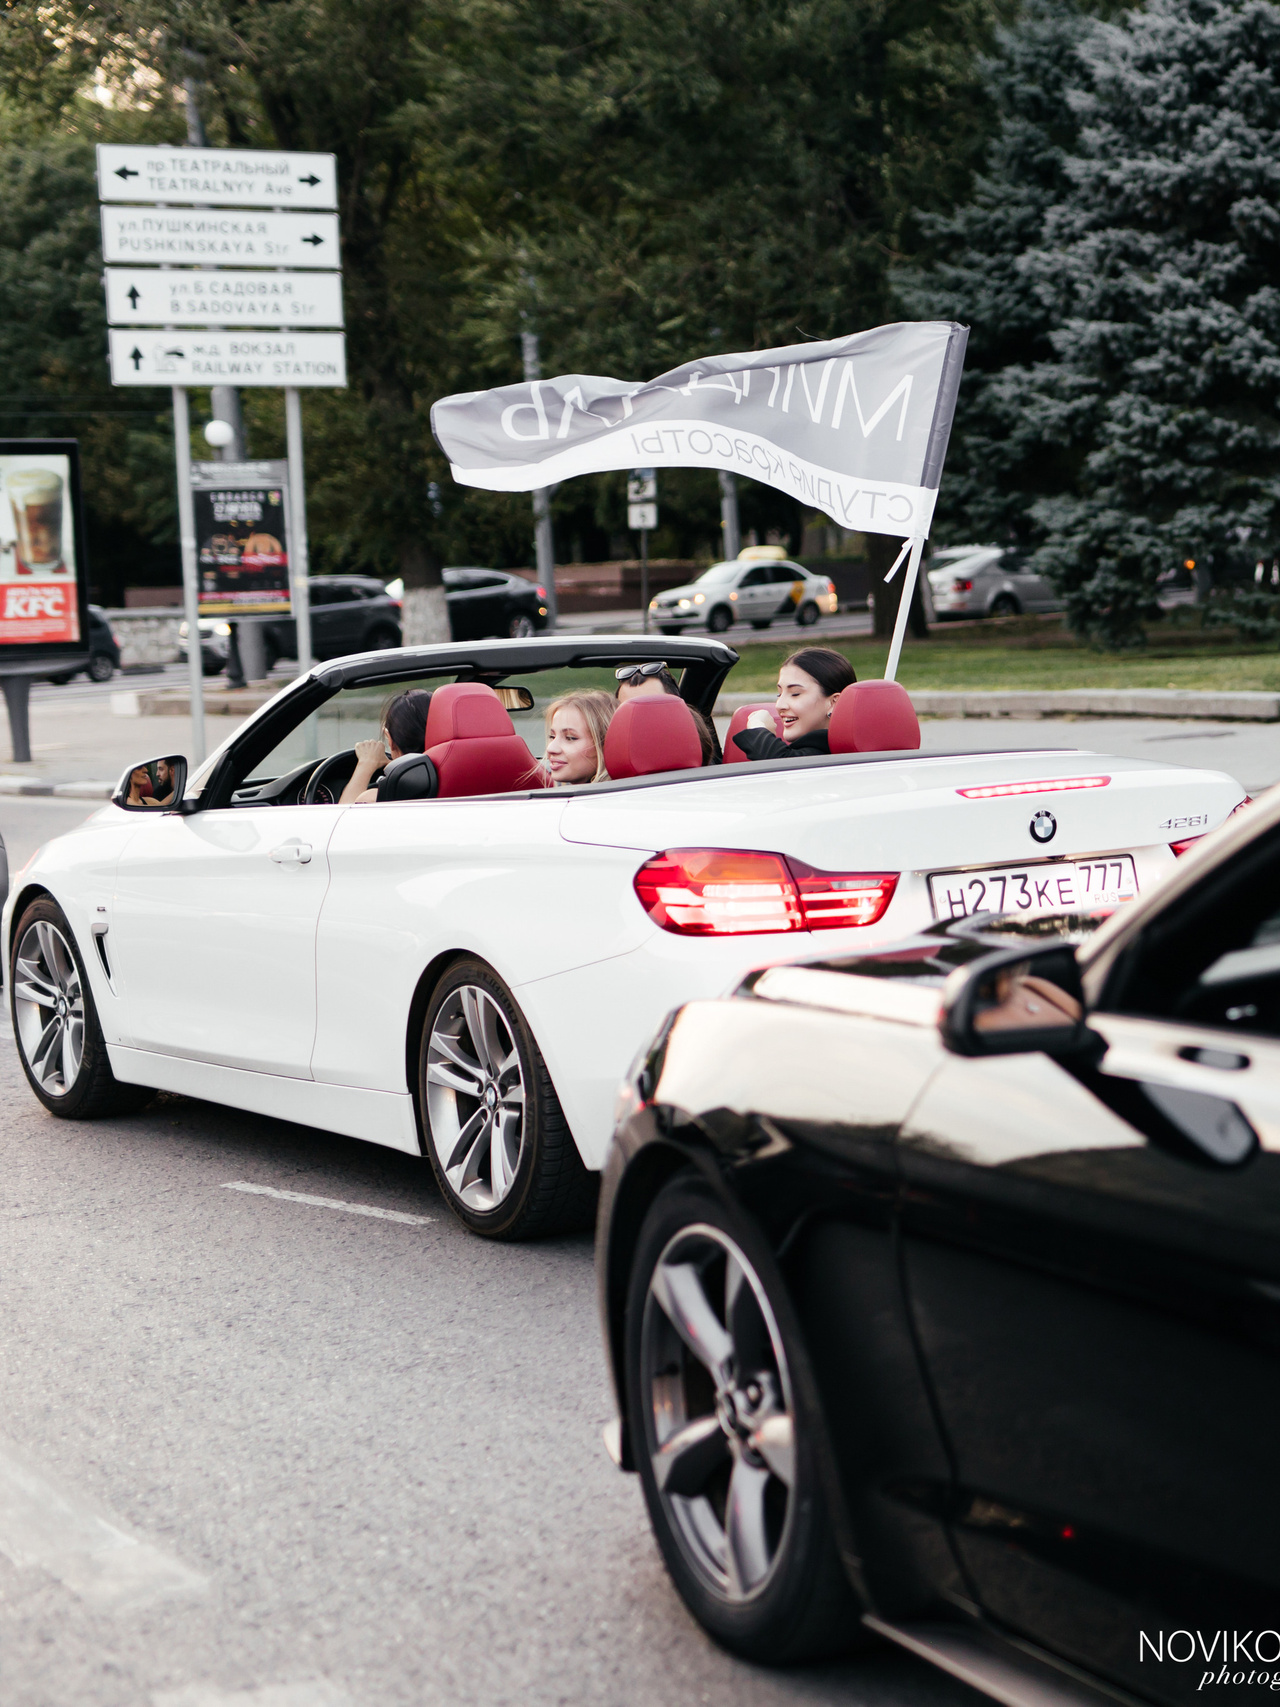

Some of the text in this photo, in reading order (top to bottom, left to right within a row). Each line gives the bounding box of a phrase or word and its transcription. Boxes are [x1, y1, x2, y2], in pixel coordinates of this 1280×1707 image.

[148, 176, 292, 195] TEATRALNYY Ave
[118, 237, 256, 254] PUSHKINSKAYA
[230, 342, 296, 355] ВОКЗАЛ
[192, 361, 337, 375] RAILWAY STATION
[3, 596, 64, 619] KFC
[1159, 814, 1208, 829] 428i
[1094, 893, 1118, 904] RUS
